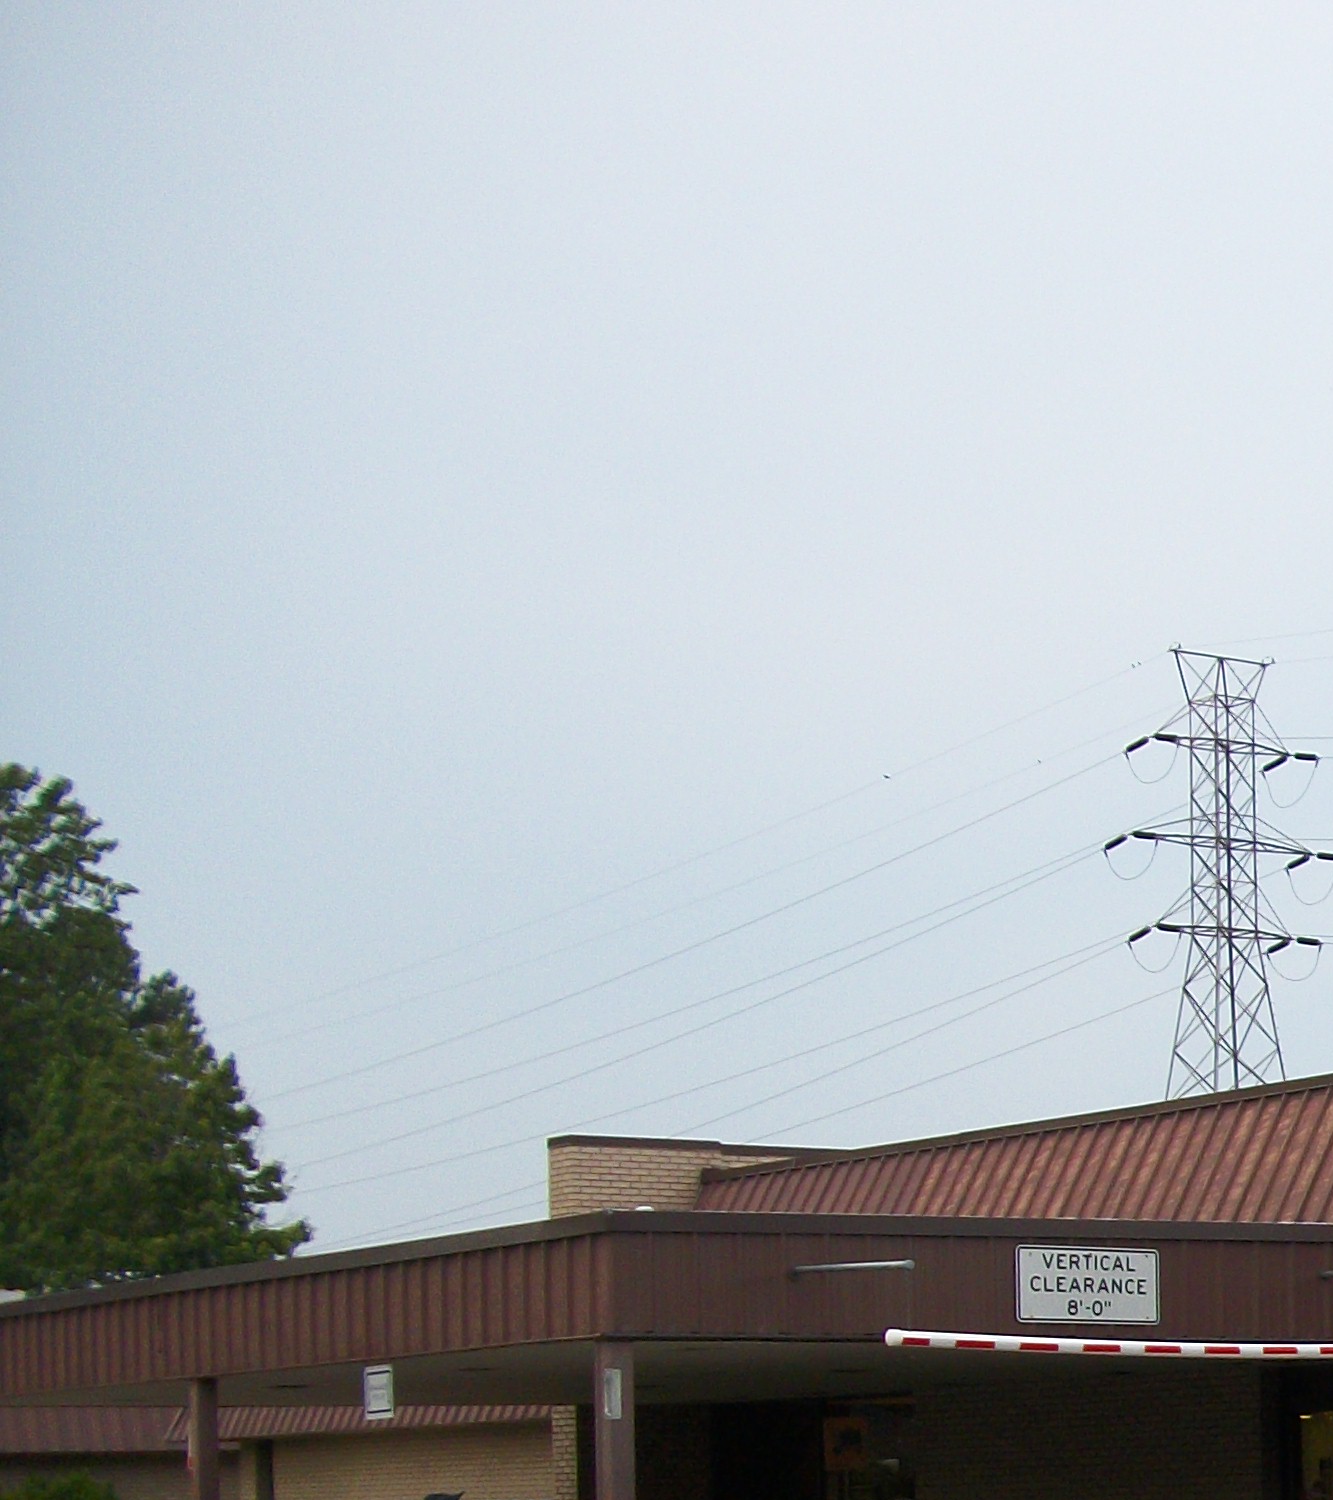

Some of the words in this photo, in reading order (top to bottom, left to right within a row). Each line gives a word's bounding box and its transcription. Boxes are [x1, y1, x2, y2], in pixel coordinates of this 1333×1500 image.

[1042, 1252, 1136, 1272] VERTICAL
[1029, 1275, 1148, 1295] CLEARANCE
[1067, 1299, 1112, 1317] 8'-0"
